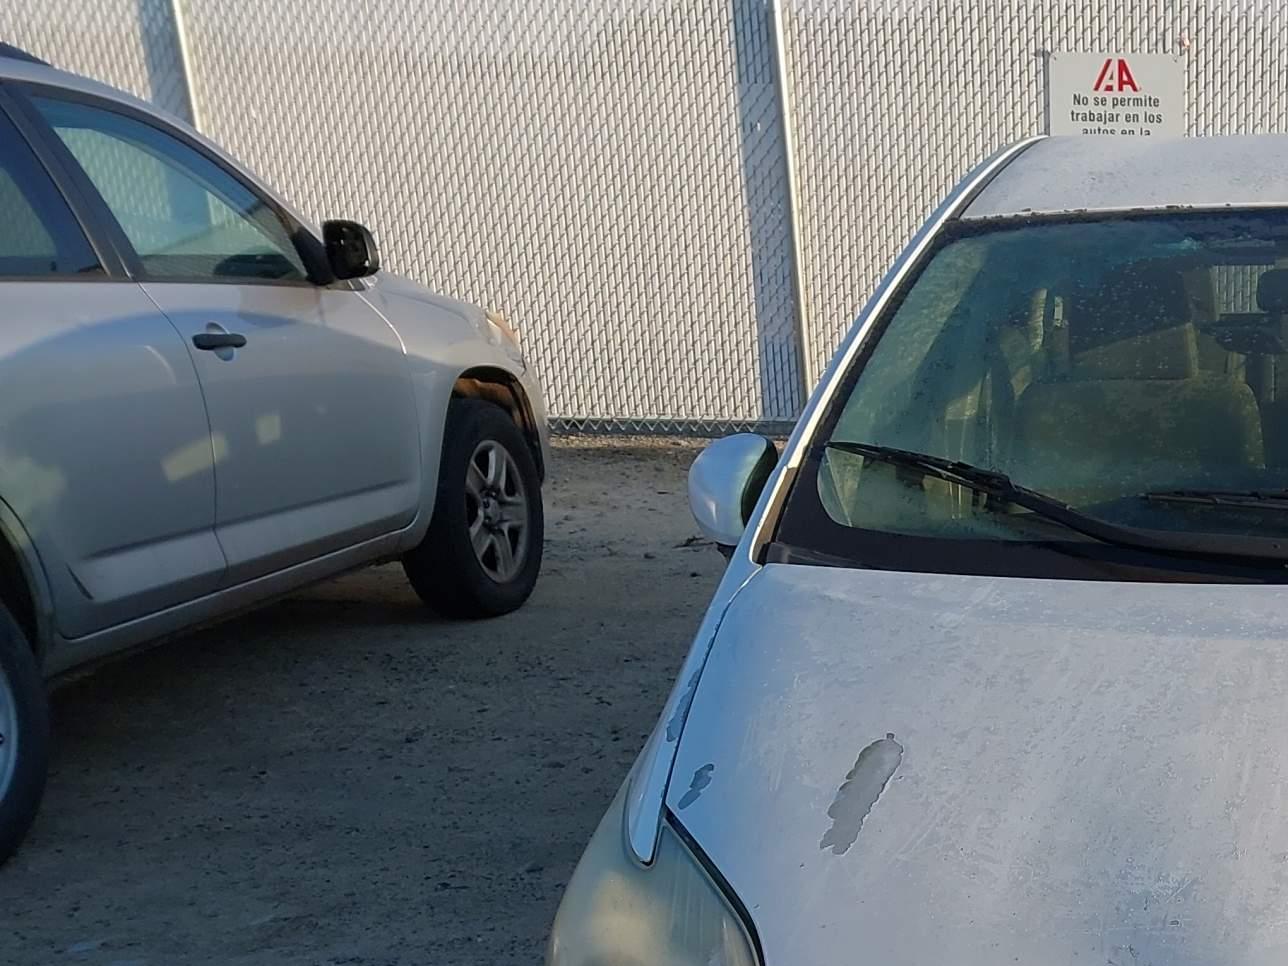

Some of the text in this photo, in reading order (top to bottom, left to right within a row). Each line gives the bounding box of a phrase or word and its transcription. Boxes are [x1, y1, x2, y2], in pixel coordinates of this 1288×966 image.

[1073, 94, 1160, 108] No se permite
[1071, 110, 1162, 125] trabajar en los
